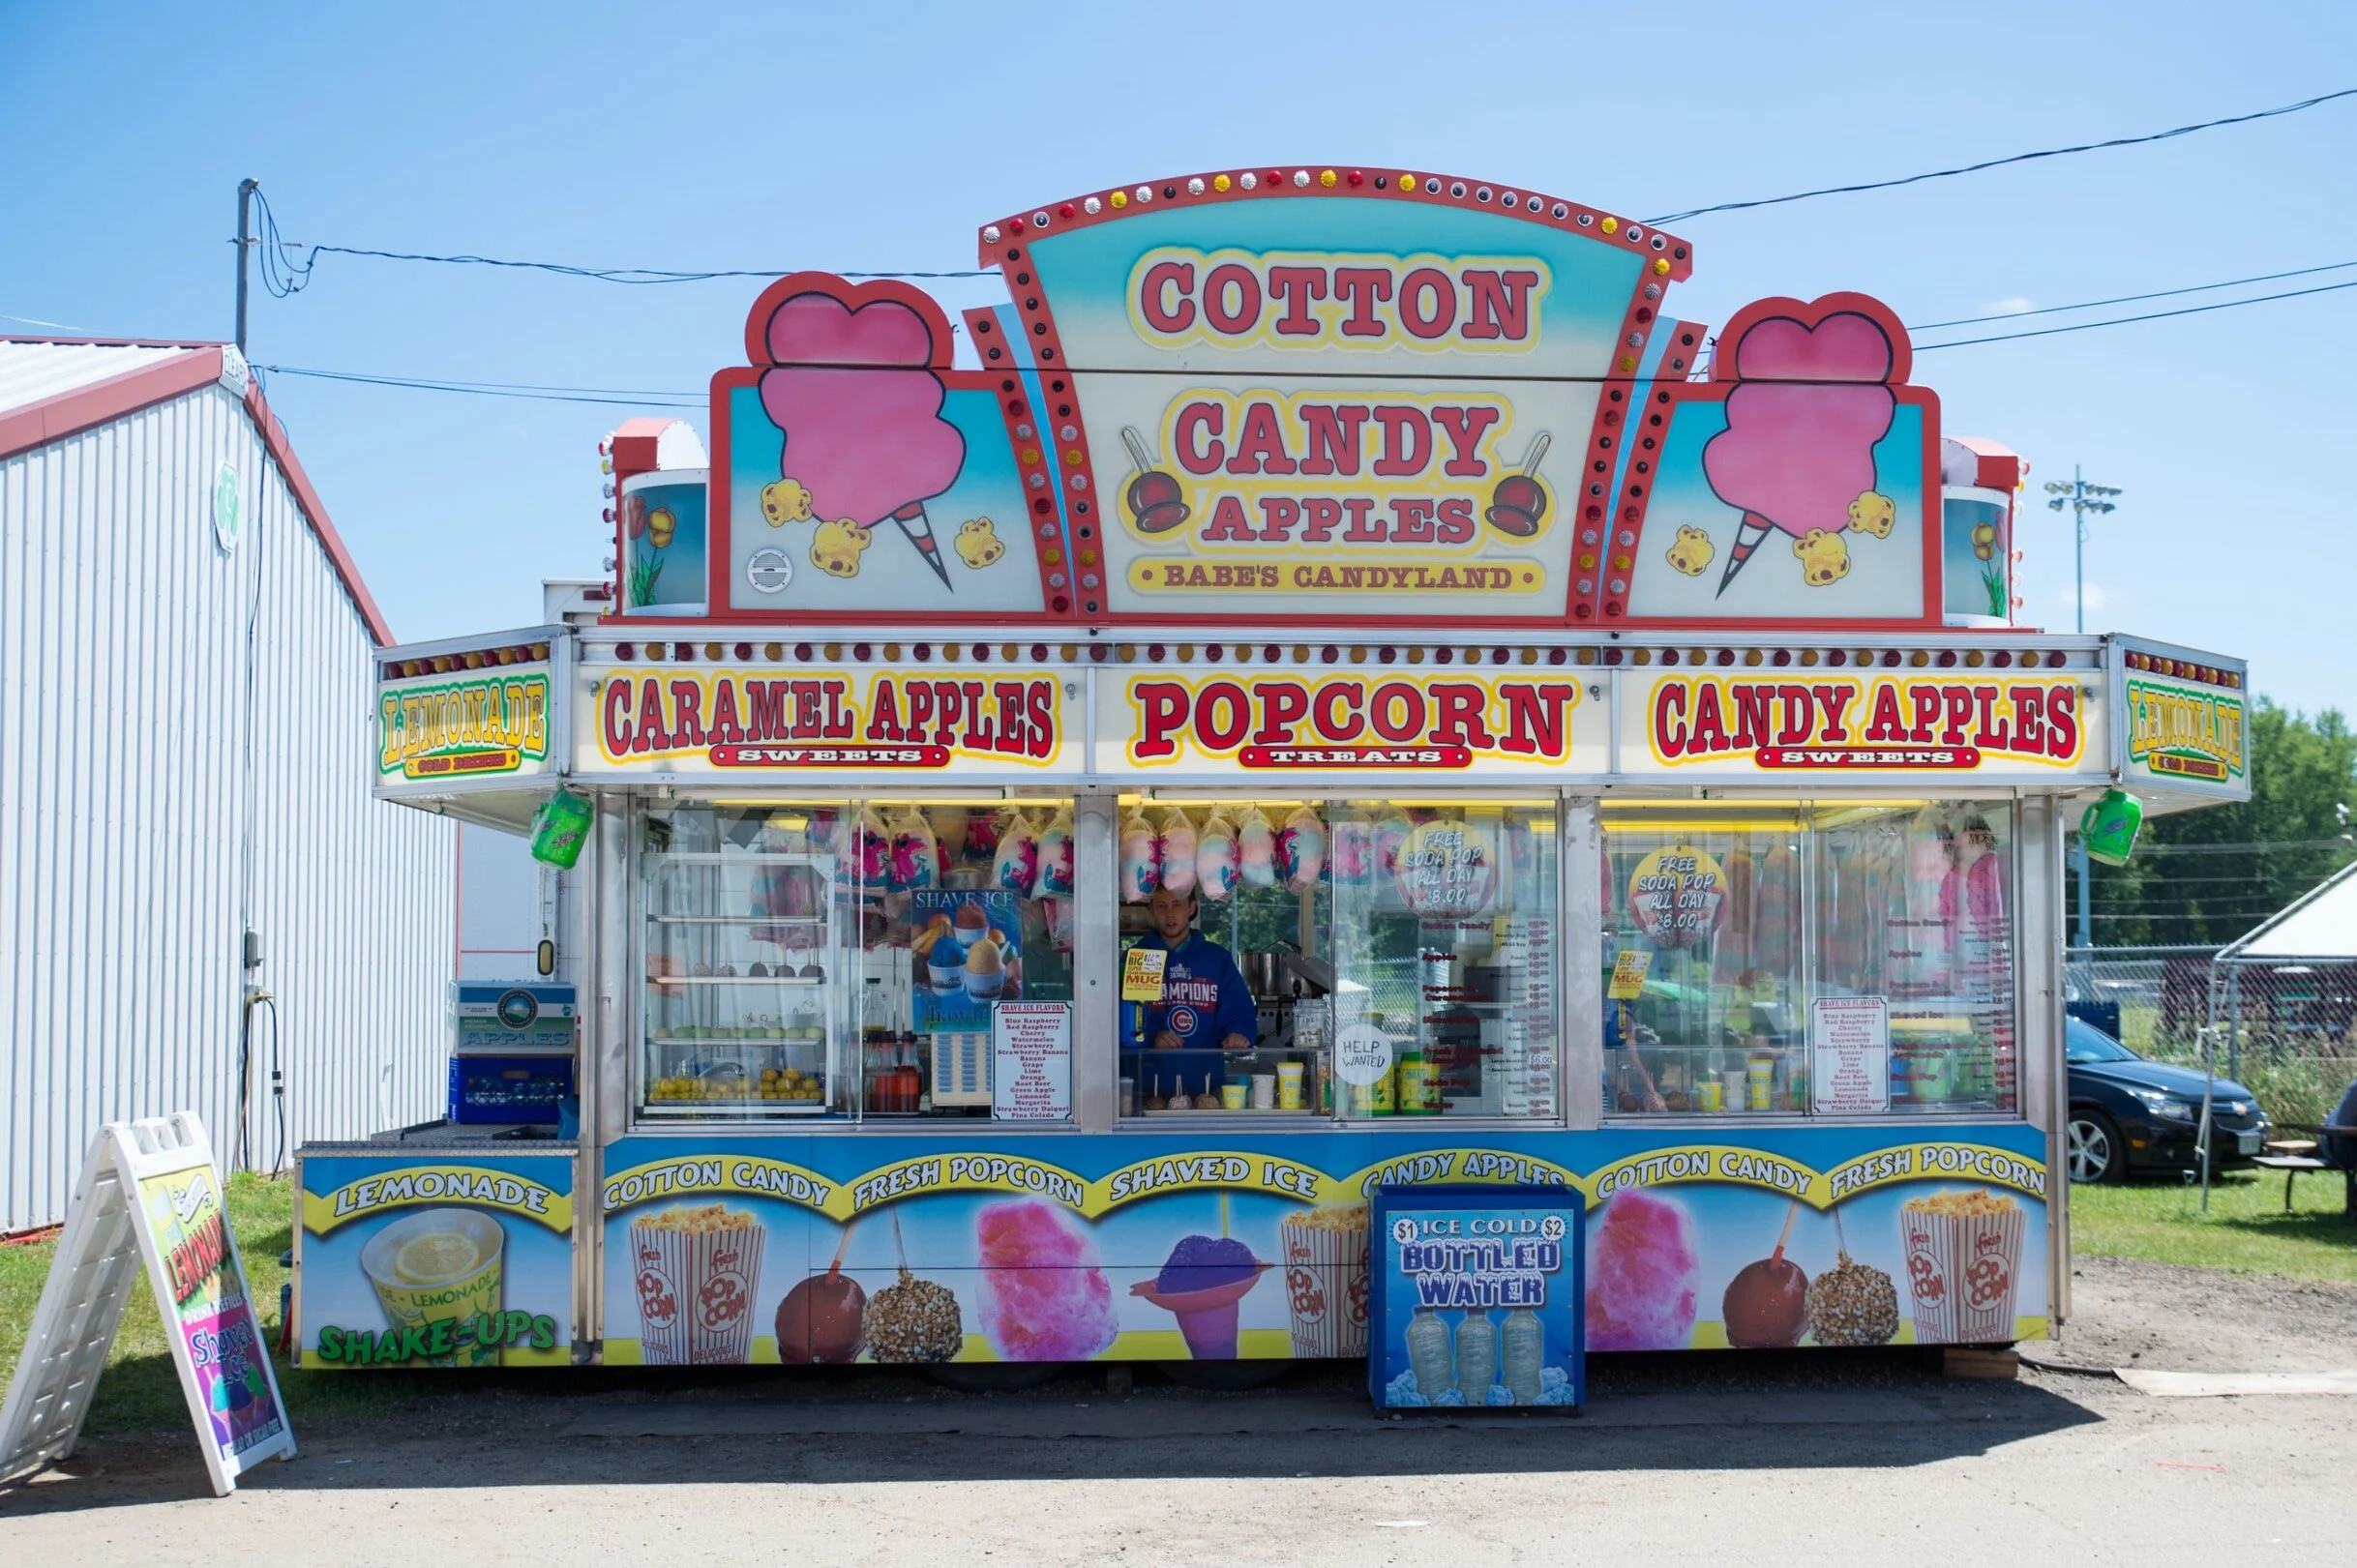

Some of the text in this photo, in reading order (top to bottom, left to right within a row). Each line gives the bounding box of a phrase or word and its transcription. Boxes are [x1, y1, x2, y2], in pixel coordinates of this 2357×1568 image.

[1142, 262, 1538, 340] COTTON
[1175, 402, 1499, 477] CANDY
[1201, 496, 1476, 543] APPLES
[1164, 565, 1512, 590] BABE'S CANDYLAND
[384, 683, 544, 766] LEMONADE
[605, 678, 1052, 758] CARAMEL APPLES
[1134, 682, 1573, 758] POPCORN
[1656, 683, 2076, 758] CANDY APPLES
[2131, 688, 2242, 771] LEMONADE
[737, 749, 922, 763] SWEETS
[1269, 750, 1443, 764] TREATS
[1780, 751, 1955, 765] SWEETS
[1424, 831, 1464, 847] FREE
[1405, 845, 1483, 868] SODA POP
[1657, 856, 1697, 873] FREE
[1417, 868, 1473, 885] ALL DAY
[1638, 872, 1716, 891] SODA POP
[915, 891, 1014, 908] SHAVE ICE
[1427, 888, 1467, 903] $8.00
[1650, 893, 1704, 909] ALL DAY
[1658, 913, 1697, 929] $8.00
[1128, 957, 1143, 965] BIG
[1126, 975, 1160, 984] MUG
[1161, 982, 1218, 1002] AMPIONS
[462, 1031, 570, 1047] APPLES
[1343, 1040, 1380, 1053] HELP
[1343, 1055, 1386, 1068] WANTED
[1531, 1054, 1552, 1065] $6.00
[603, 1161, 831, 1211] COTTON CANDY
[853, 1158, 1085, 1211] FRESH POPCORN
[1110, 1157, 1319, 1201] SHAVED ICE
[1361, 1153, 1565, 1198] CANDY APPLES
[1596, 1152, 1813, 1200] COTTON CANDY
[1830, 1147, 2046, 1199] FRESH POPCORN
[334, 1171, 550, 1218] LEMONADE
[1397, 1222, 1416, 1240] $1
[1421, 1219, 1537, 1235] ICE COLD
[1544, 1219, 1562, 1237] $2
[711, 1248, 739, 1274] fresh
[1400, 1237, 1563, 1273] BOTTLED
[1908, 1255, 1932, 1280] POP
[638, 1272, 664, 1300] POP
[1288, 1268, 1313, 1295] POP
[1914, 1274, 1944, 1300] CORN
[1966, 1259, 1999, 1289] POP
[409, 1270, 492, 1308] LEMONADE
[701, 1277, 736, 1308] POP
[1348, 1275, 1368, 1306] PO
[1416, 1271, 1545, 1306] WATER
[1971, 1271, 2009, 1306] CORN
[643, 1292, 676, 1321] CORN
[704, 1288, 746, 1326] CORN
[1293, 1288, 1326, 1317] CORN
[317, 1309, 556, 1366] SHAKE-UPS
[694, 1343, 732, 1362] DELICIOUS
